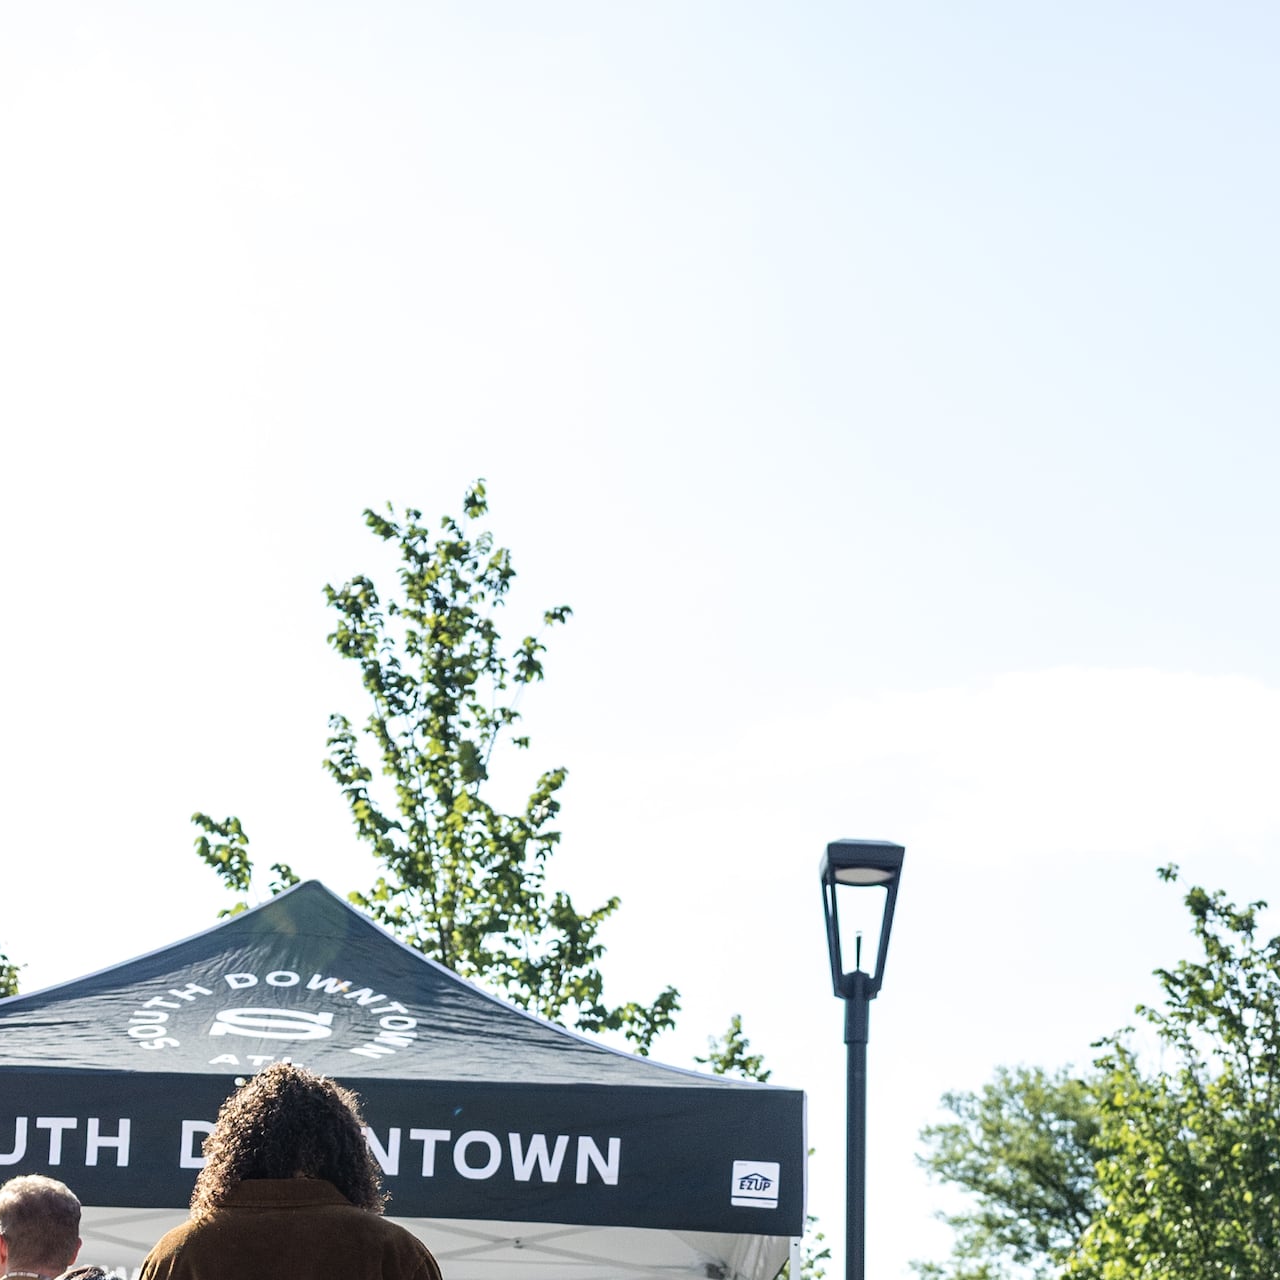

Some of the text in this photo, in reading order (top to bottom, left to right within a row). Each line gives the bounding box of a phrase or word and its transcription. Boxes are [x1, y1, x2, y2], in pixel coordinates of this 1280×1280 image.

[127, 970, 418, 1059] SOUTH DOWNTOWN
[179, 1118, 621, 1186] DNTOWN
